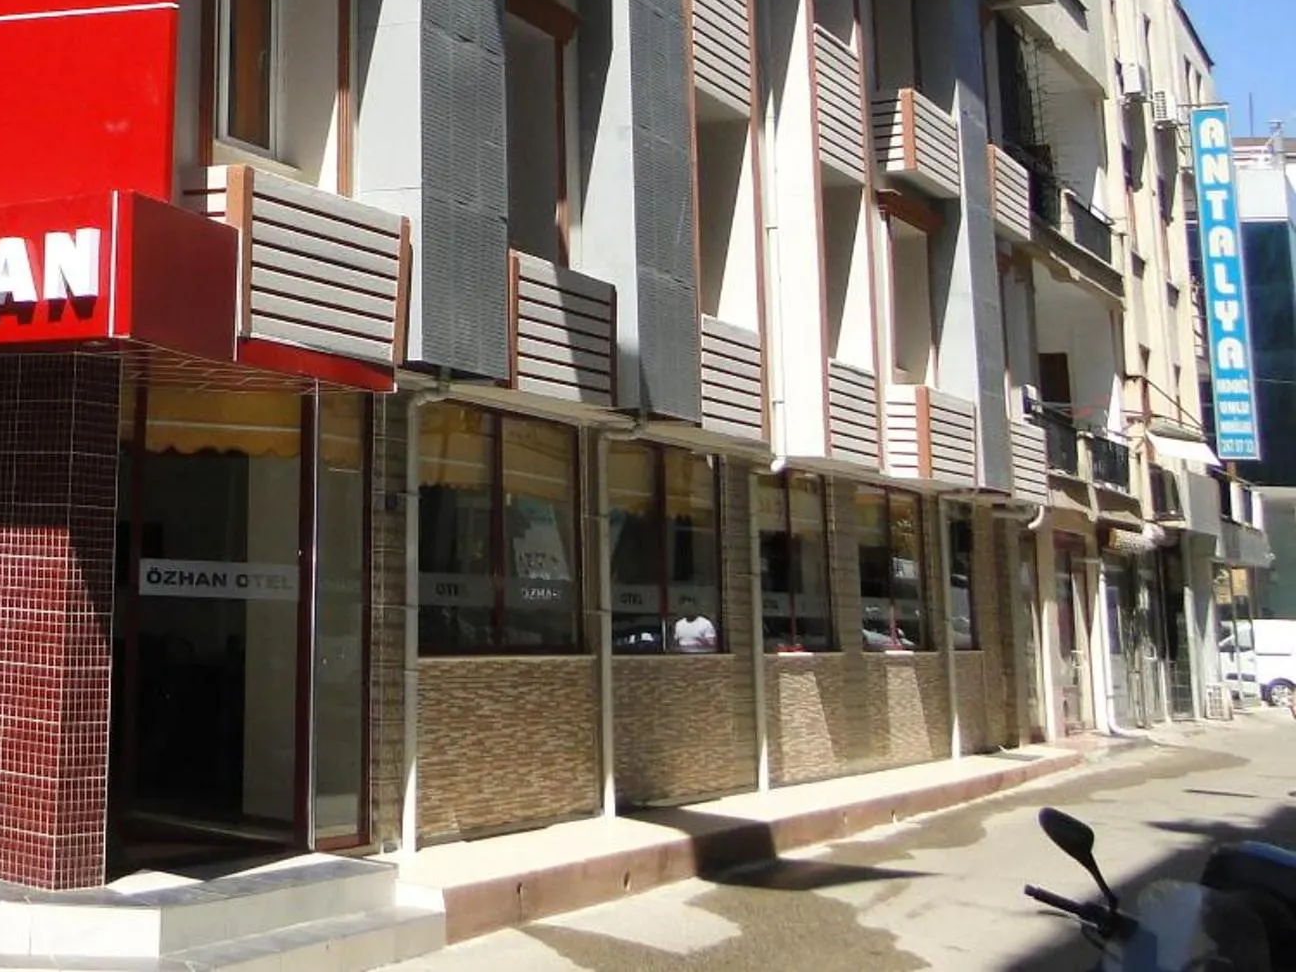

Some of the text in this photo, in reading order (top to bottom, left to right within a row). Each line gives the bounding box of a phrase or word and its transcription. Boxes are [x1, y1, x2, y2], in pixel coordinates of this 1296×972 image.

[1199, 117, 1245, 370] ANTALYA
[147, 567, 293, 590] ÖZHAN OTEL
